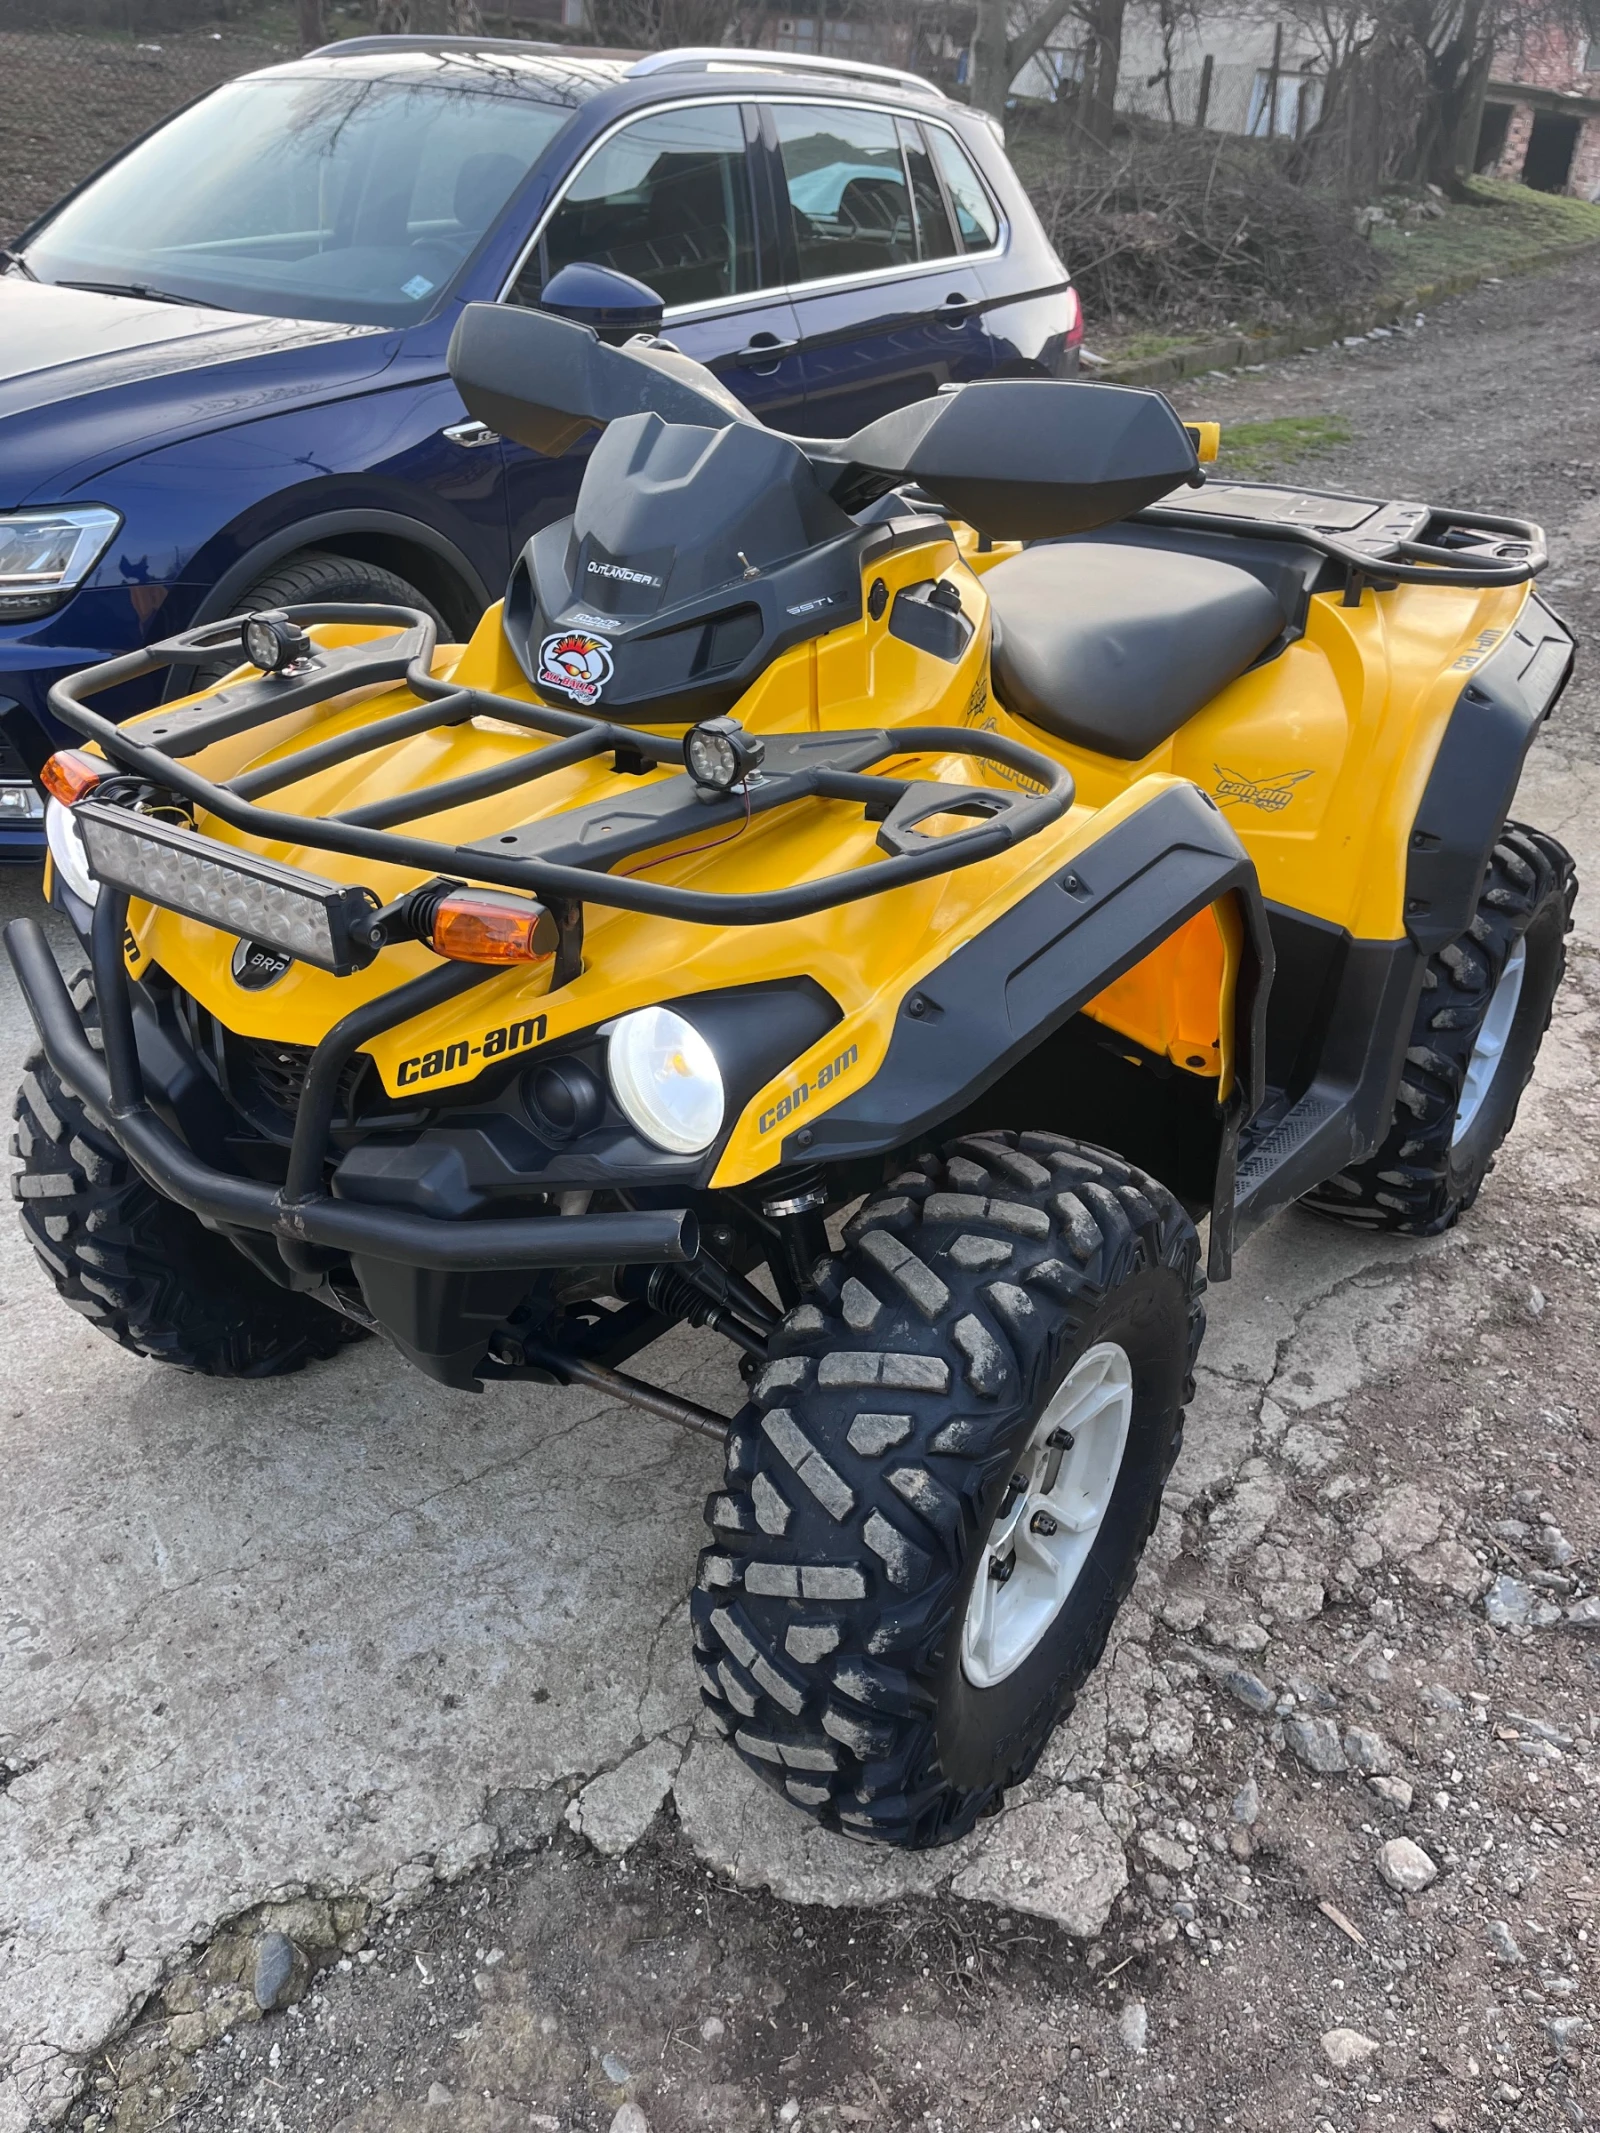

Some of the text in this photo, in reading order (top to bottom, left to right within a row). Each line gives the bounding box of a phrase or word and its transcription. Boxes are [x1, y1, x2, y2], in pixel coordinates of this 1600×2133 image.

[587, 561, 662, 587] OUTLANDER L
[541, 671, 596, 694] ALL BALLS
[1217, 780, 1292, 804] can-am
[251, 953, 285, 971] BRP
[397, 1014, 547, 1086] can-am
[759, 1044, 858, 1134] can-am
